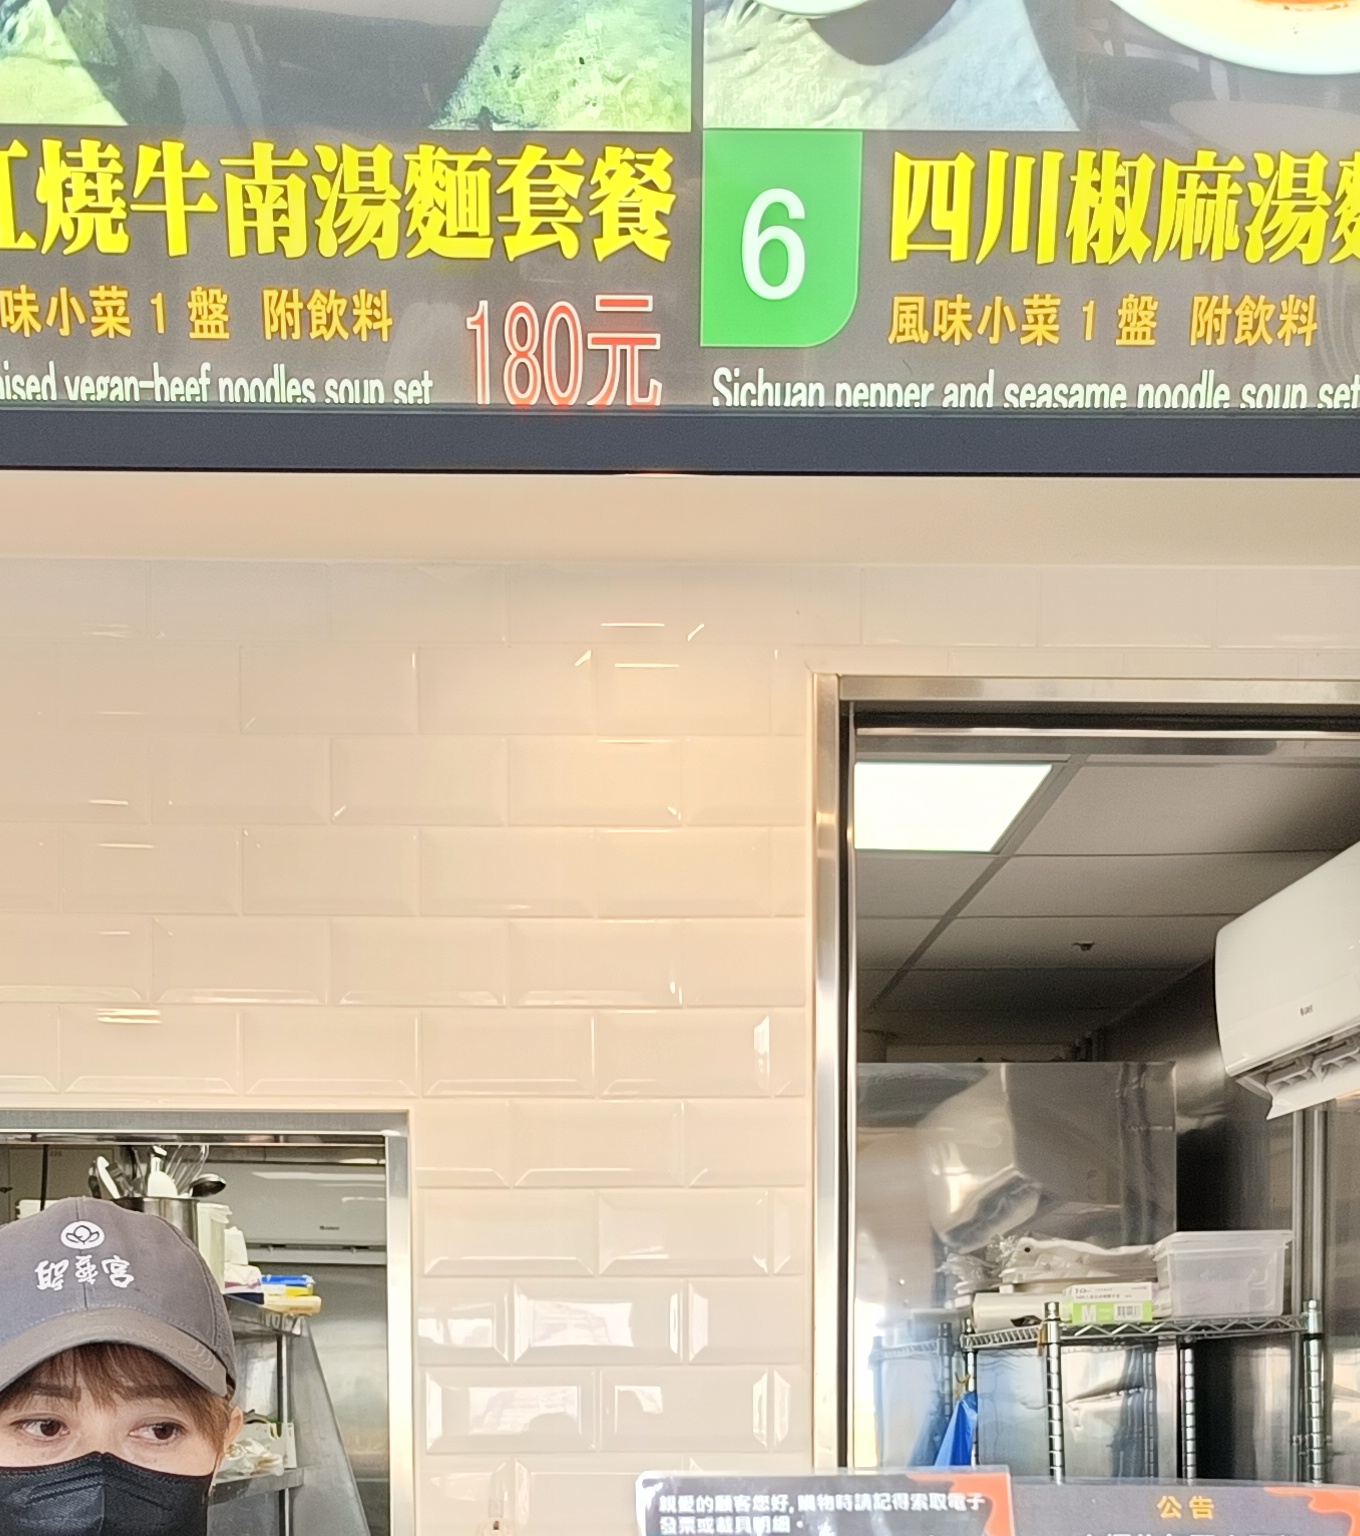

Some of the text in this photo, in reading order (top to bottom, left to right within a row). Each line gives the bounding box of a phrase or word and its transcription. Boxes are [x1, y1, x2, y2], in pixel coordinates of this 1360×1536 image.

[739, 186, 808, 302] 6
[188, 286, 231, 341] 盤
[261, 287, 394, 342] 附飲料
[887, 293, 1062, 346] 風味小菜
[1116, 295, 1159, 346] 盤
[1189, 294, 1319, 347] 附飲料
[466, 293, 664, 406] 180元
[218, 364, 315, 404] noodles
[394, 370, 434, 404] set
[711, 366, 825, 408] Sichuan
[942, 369, 995, 409] and
[1137, 369, 1230, 409] noodle
[1156, 1494, 1216, 1521] 公告
